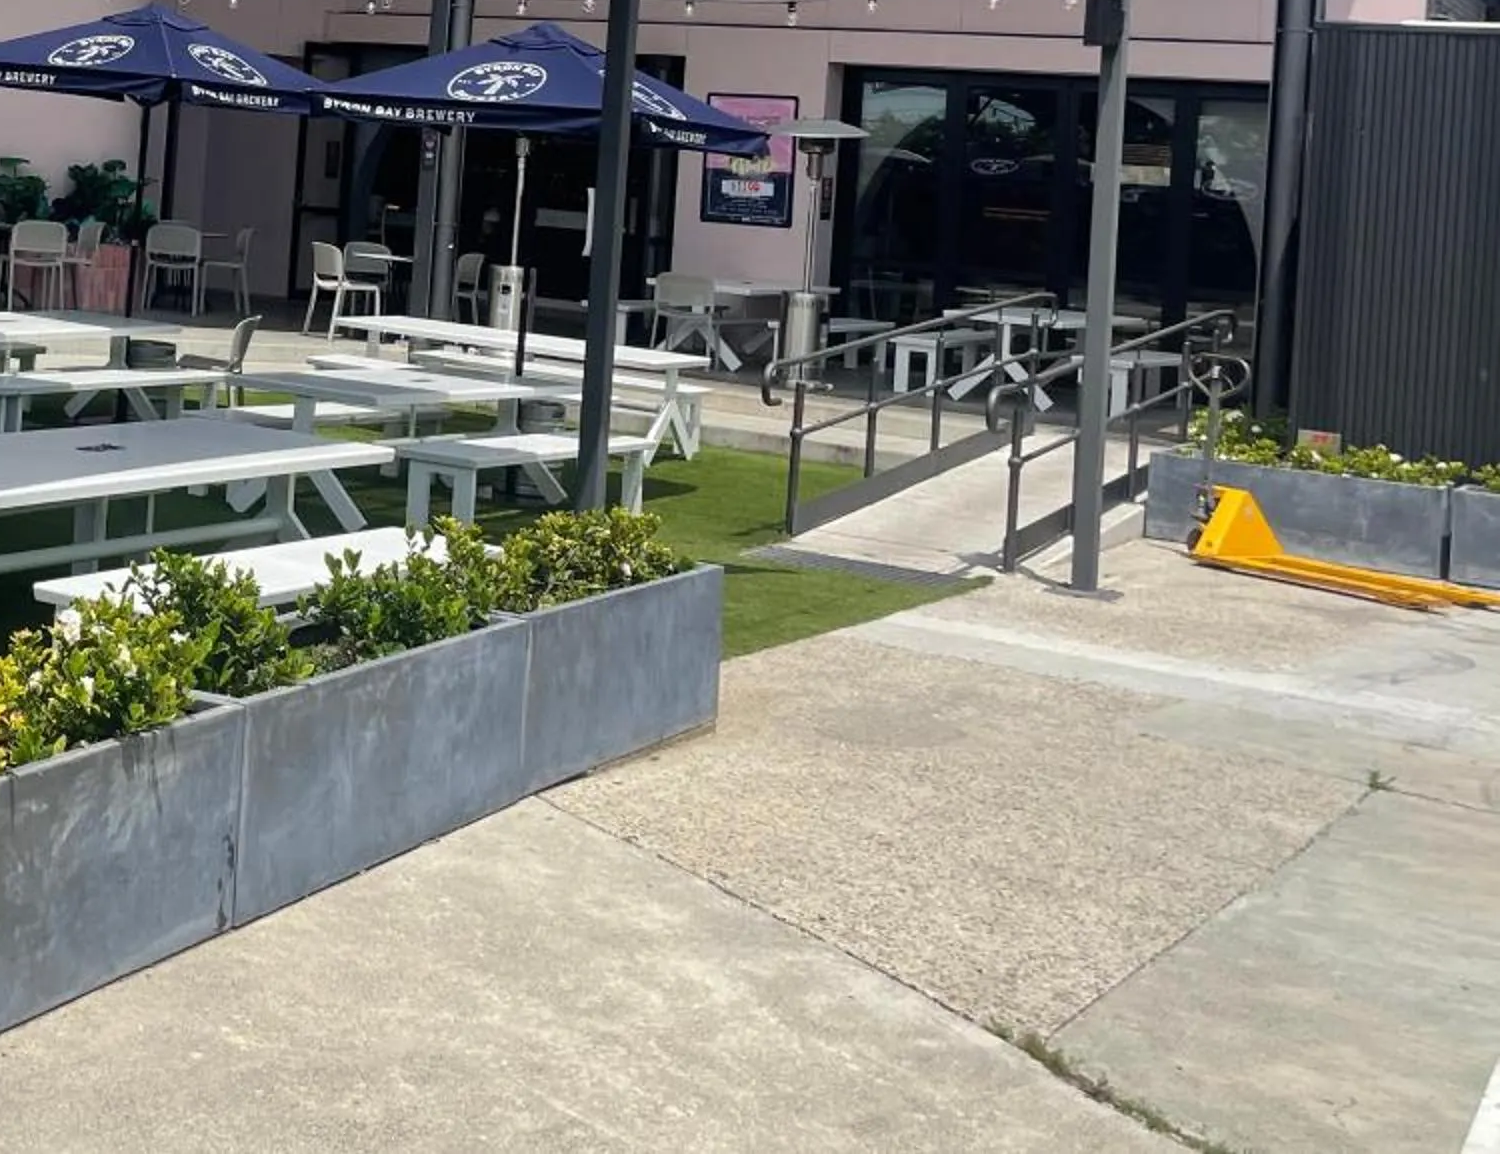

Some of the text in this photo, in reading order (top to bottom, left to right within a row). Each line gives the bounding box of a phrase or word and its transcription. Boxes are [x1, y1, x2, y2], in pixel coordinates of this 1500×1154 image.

[4, 71, 56, 86] BREWERY
[323, 97, 475, 124] BYRON BAY BREWERY
